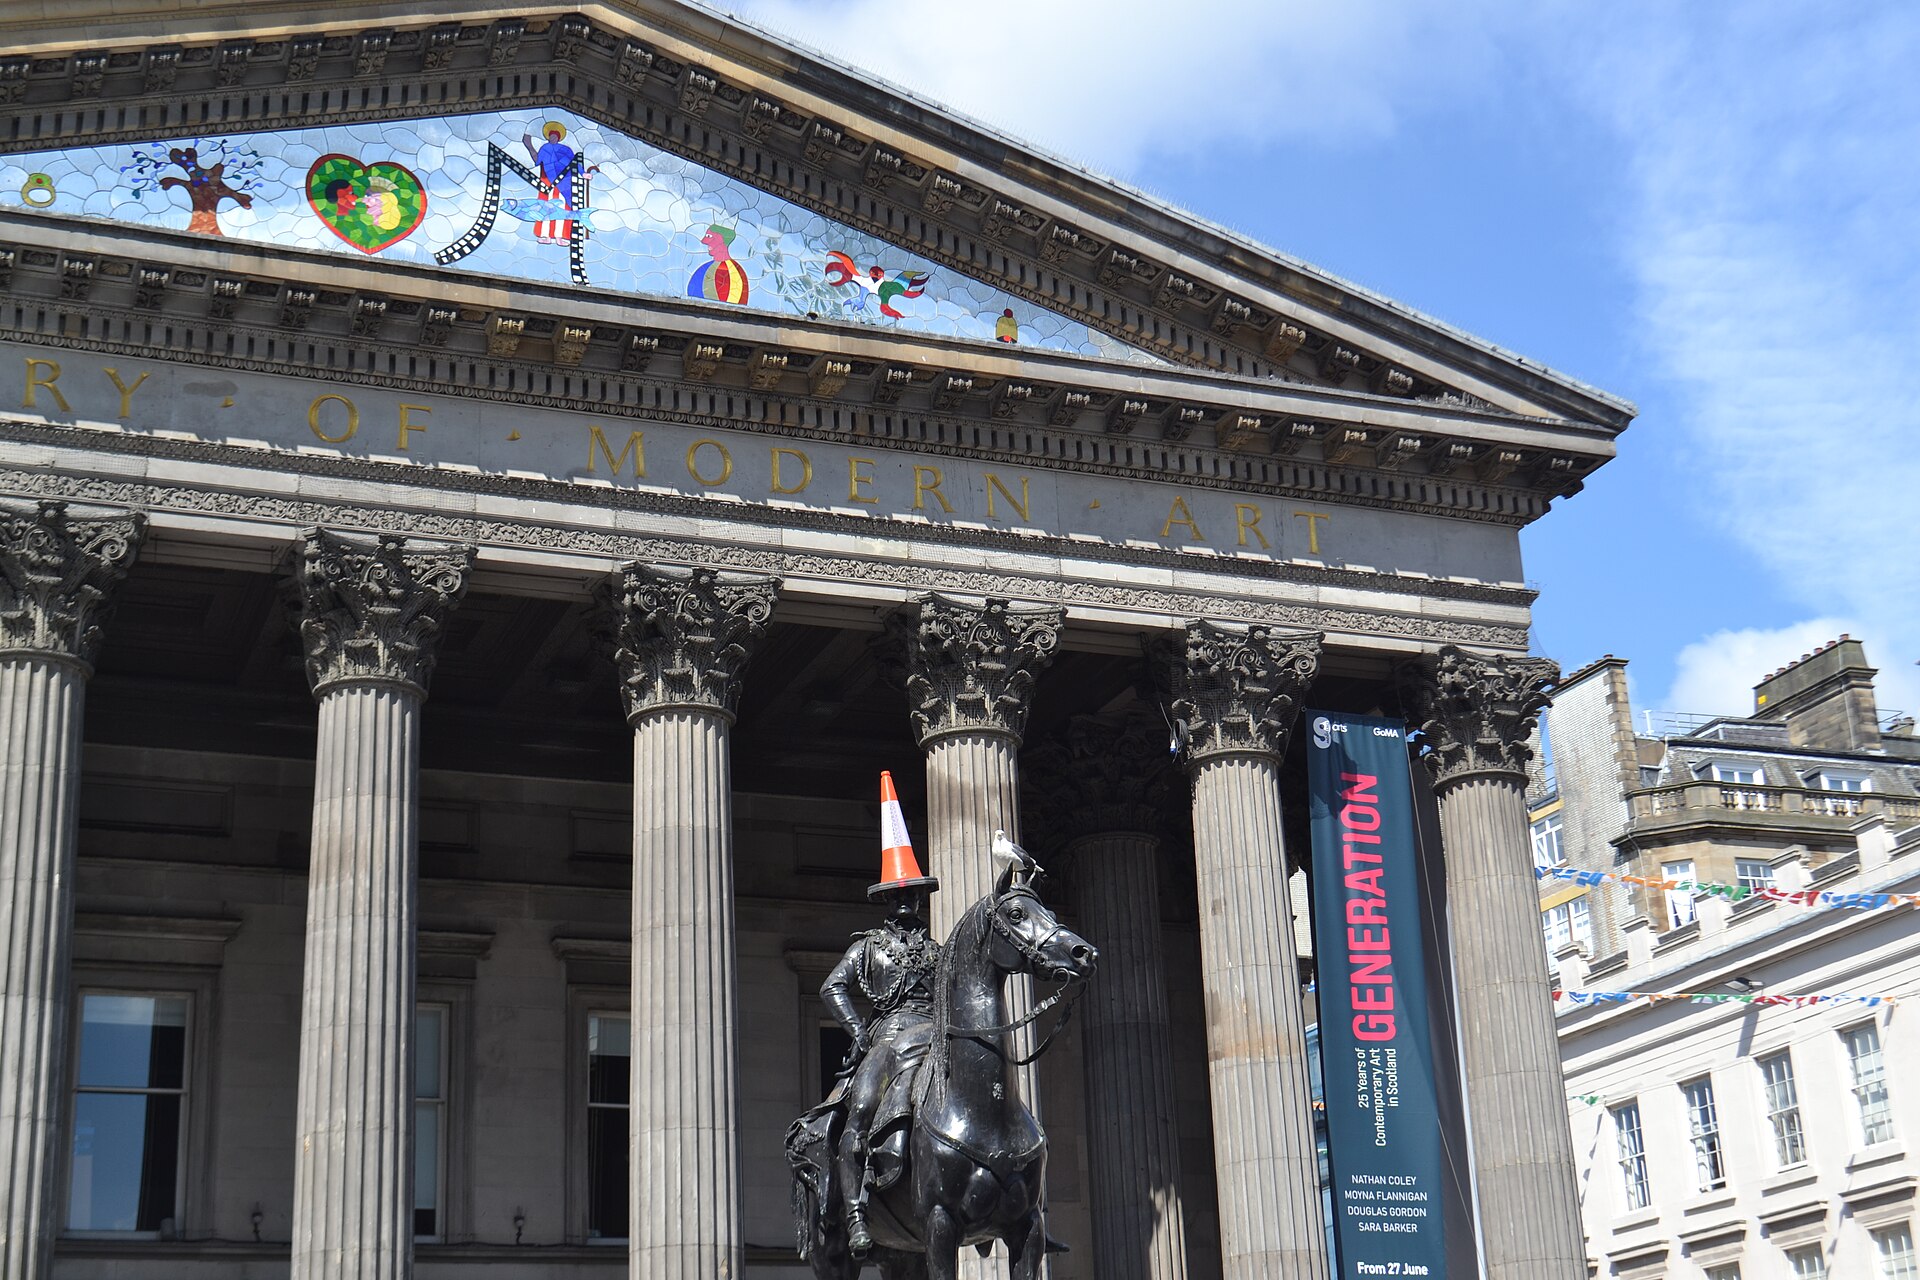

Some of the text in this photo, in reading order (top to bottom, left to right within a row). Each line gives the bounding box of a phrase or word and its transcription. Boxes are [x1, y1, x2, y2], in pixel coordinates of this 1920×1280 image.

[22, 357, 1330, 555] RY OF MODERN ART
[1373, 727, 1399, 738] GoMA
[1340, 772, 1396, 1041] GENERATION
[1354, 1047, 1369, 1108] 25 Years of
[1384, 1048, 1399, 1107] in Scotland
[1369, 1047, 1387, 1147] Contemporary Art
[1351, 1174, 1417, 1186] NATHAN COLEY
[1344, 1190, 1428, 1202] MOYNA FLANNIGAN
[1347, 1206, 1427, 1217] DOUGLAS GORDON
[1358, 1222, 1418, 1233] SARA BARKER
[1357, 1261, 1429, 1276] From 27 June
